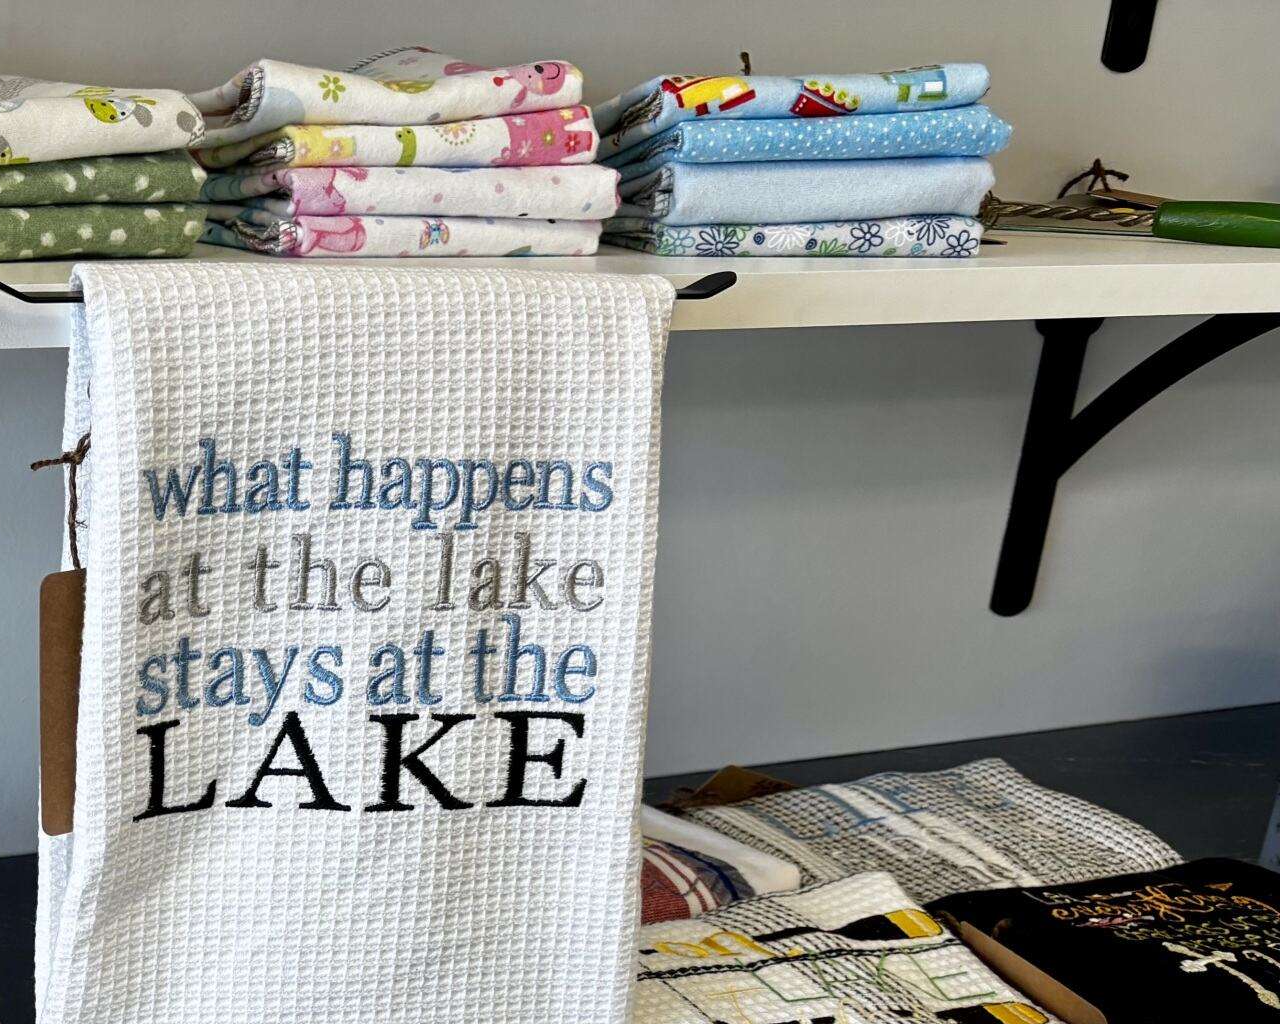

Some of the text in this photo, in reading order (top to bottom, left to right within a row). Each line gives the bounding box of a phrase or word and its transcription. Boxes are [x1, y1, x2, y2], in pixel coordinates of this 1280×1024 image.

[143, 434, 614, 531] what happens
[138, 532, 605, 626] at the lake
[135, 614, 598, 727] stays at the
[133, 709, 588, 823] LAKE
